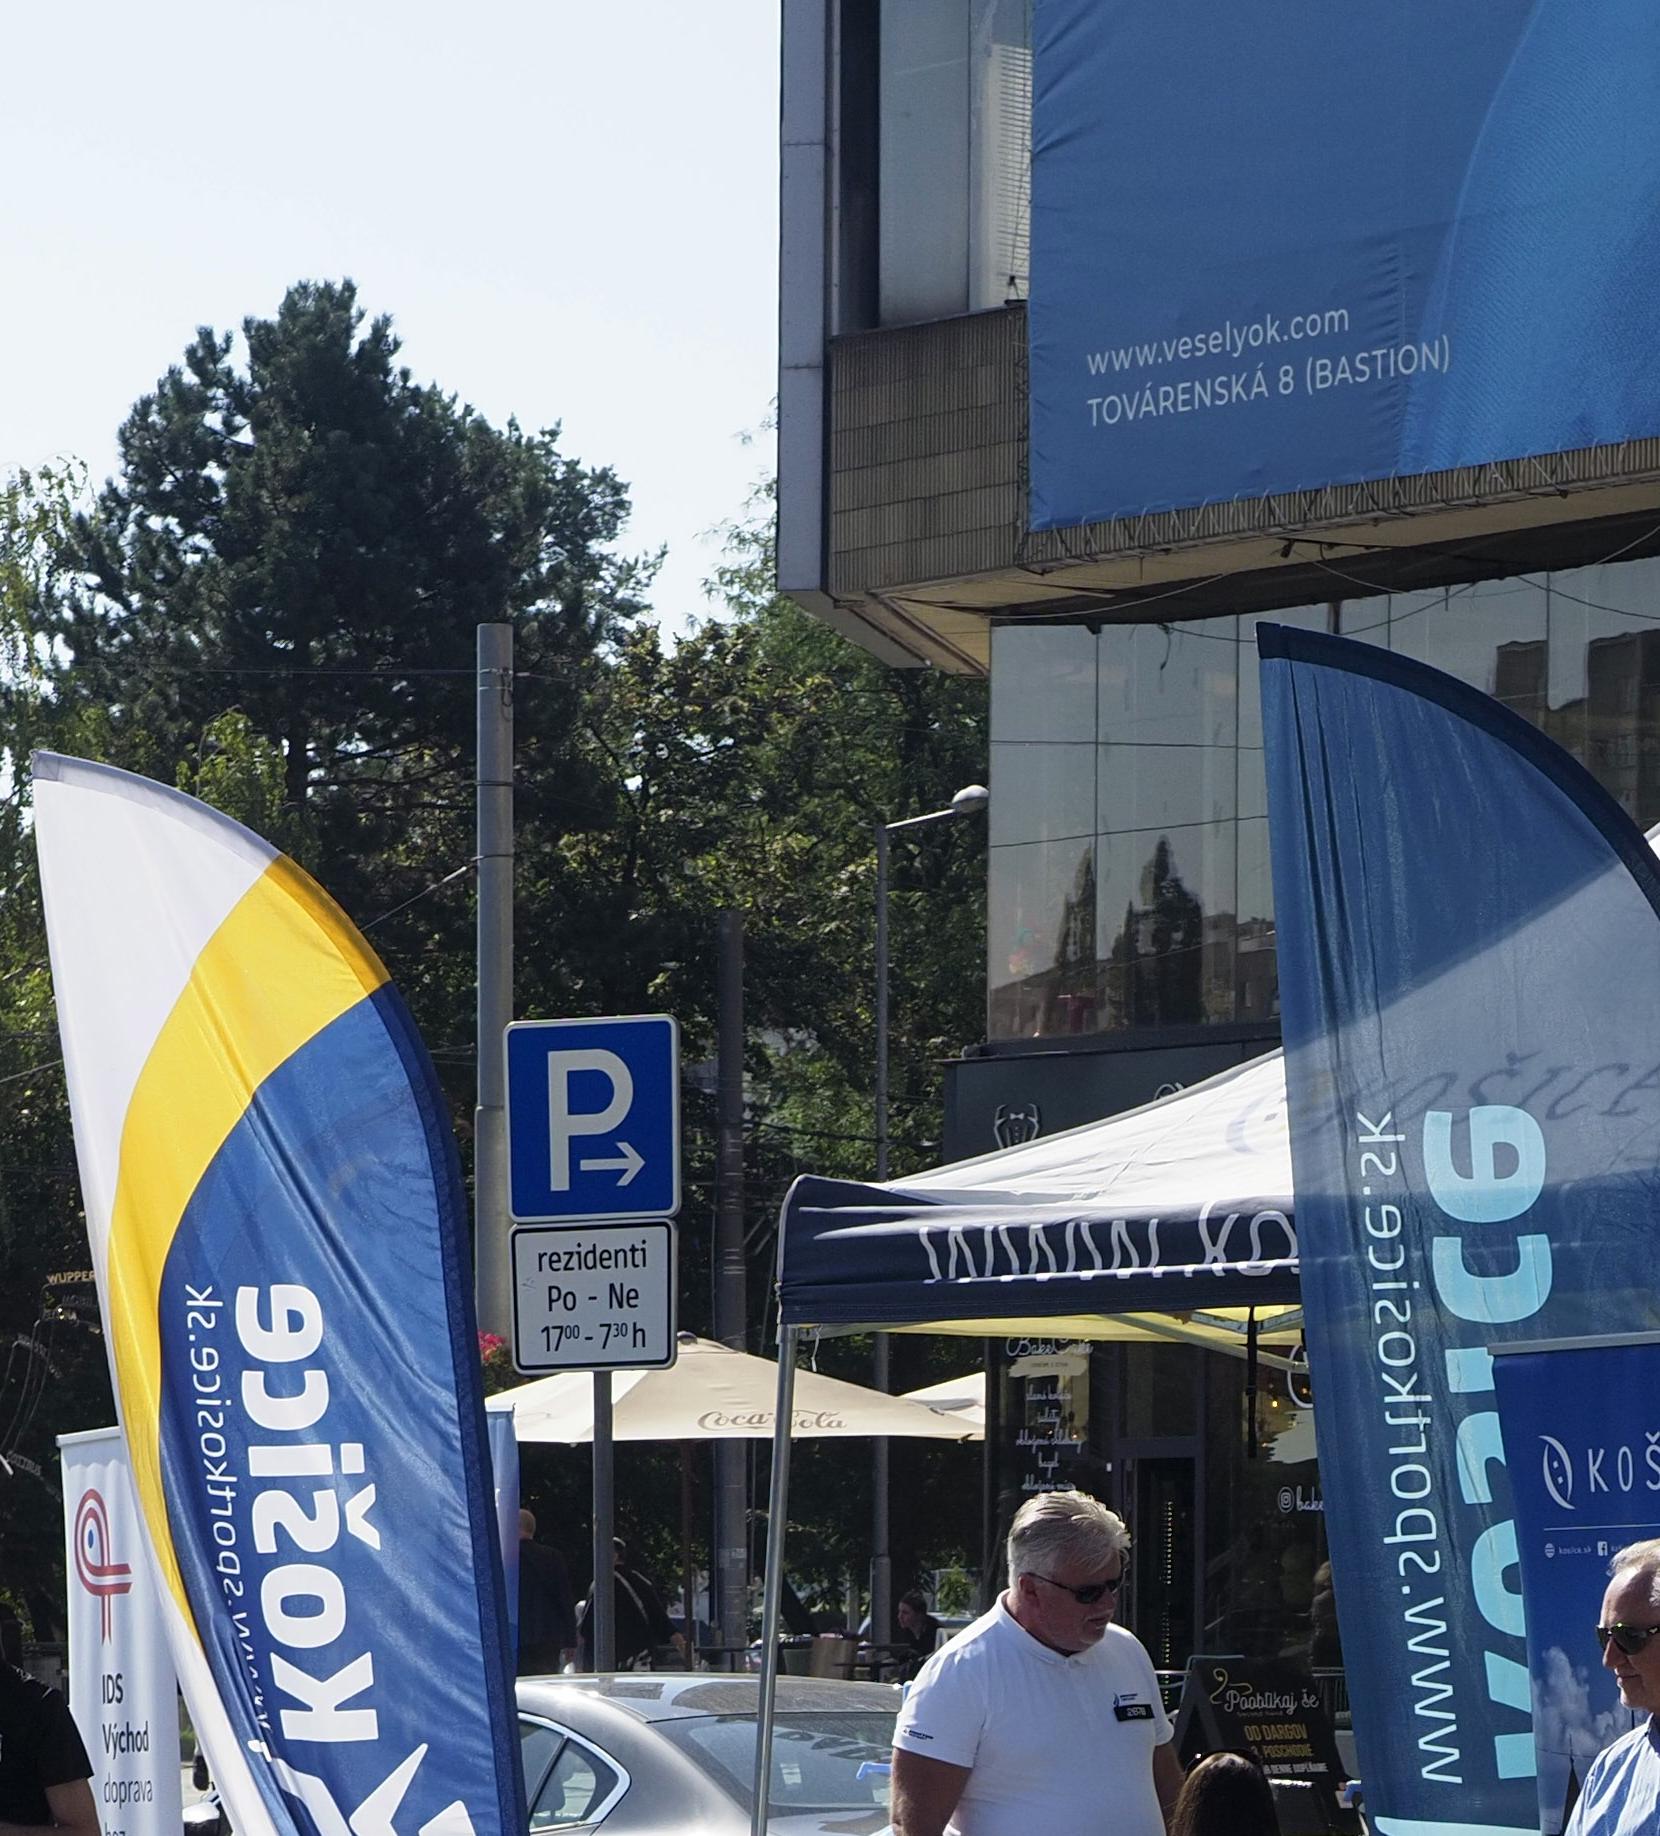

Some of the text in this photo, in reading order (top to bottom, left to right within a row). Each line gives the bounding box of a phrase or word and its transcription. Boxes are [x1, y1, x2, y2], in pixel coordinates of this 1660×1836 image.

[1087, 305, 1350, 376] www.veselyok.com
[1087, 334, 1452, 427] TOVÁRENSKÁ 8 (BASTION)
[548, 1049, 633, 1191] P
[538, 1240, 648, 1272] rezidenti
[547, 1285, 577, 1312] Po
[609, 1282, 639, 1310] Ne
[633, 1319, 646, 1348] h
[101, 1672, 124, 1705] IDS
[102, 1720, 150, 1758] Východ
[1262, 1723, 1307, 1739] DARGOV
[103, 1776, 153, 1809] doprava
